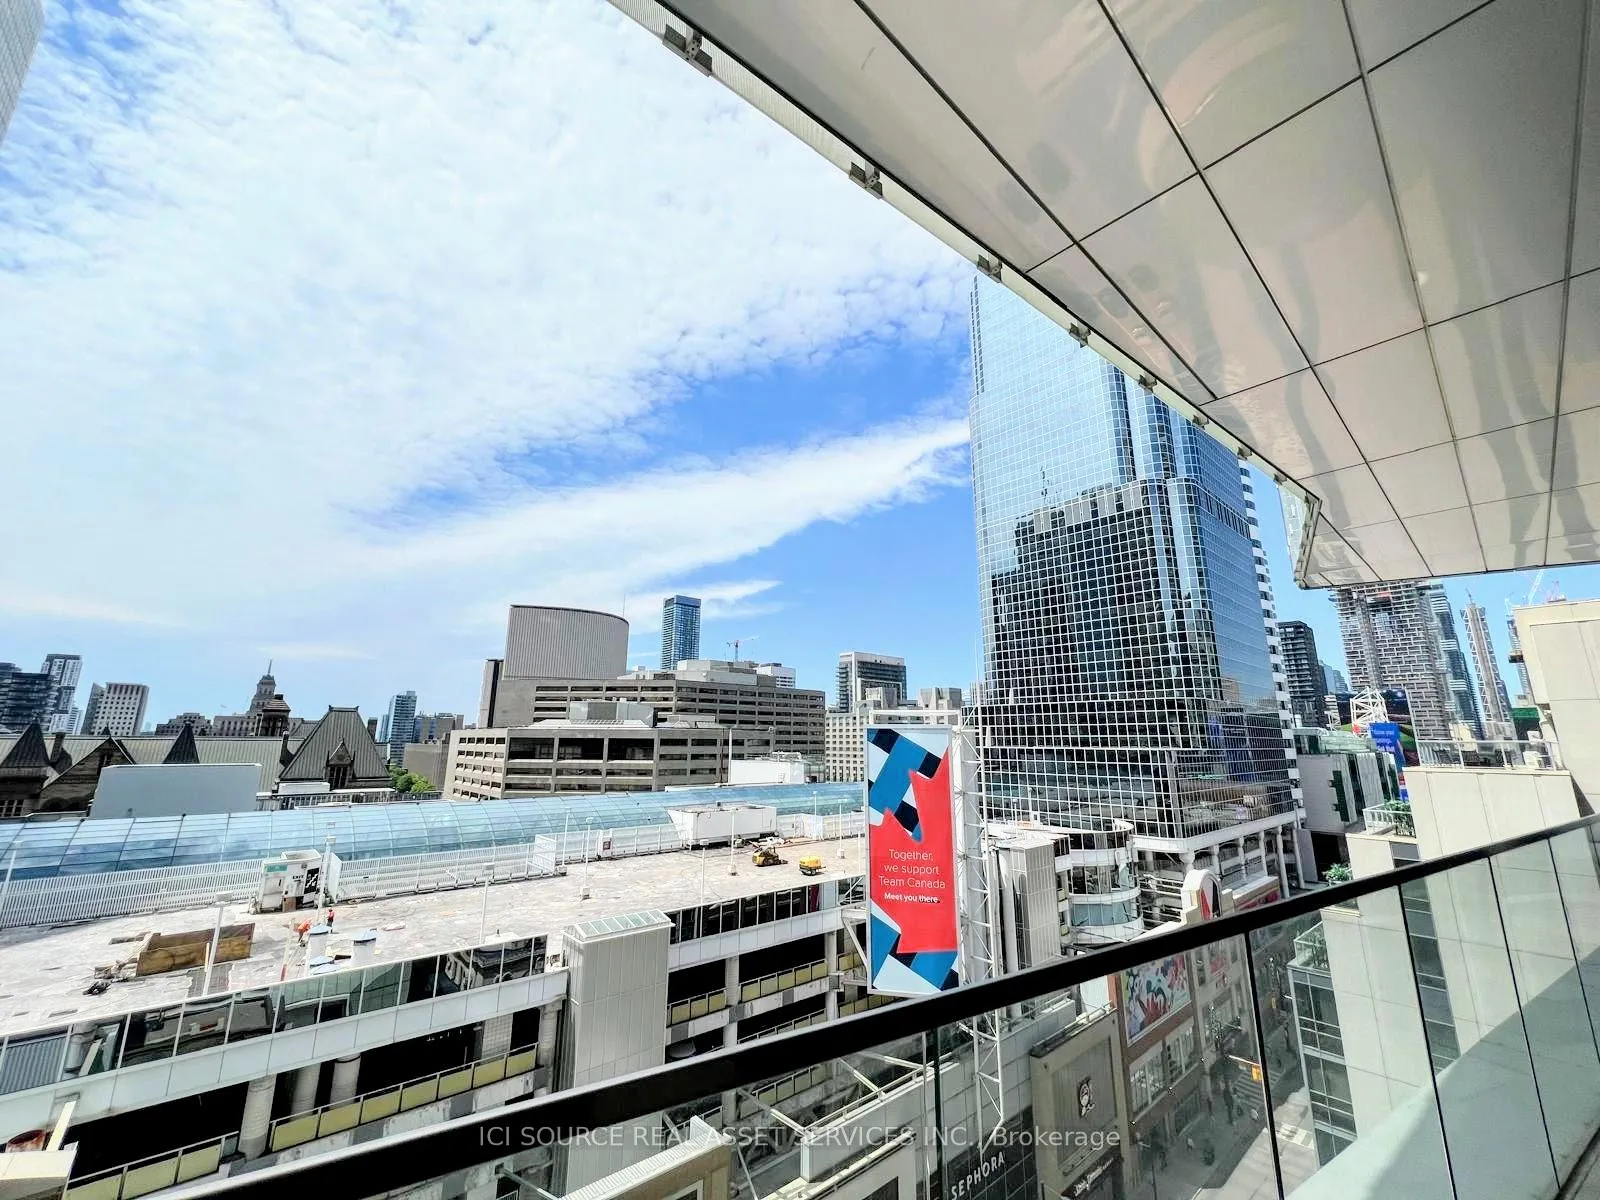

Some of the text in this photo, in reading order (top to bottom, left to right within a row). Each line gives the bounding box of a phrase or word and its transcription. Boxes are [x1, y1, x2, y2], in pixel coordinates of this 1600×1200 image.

[884, 865, 940, 876] we support
[879, 876, 946, 889] Team Canada
[884, 892, 903, 901] Meet
[903, 894, 918, 903] you
[951, 1151, 1005, 1200] SEPHORA
